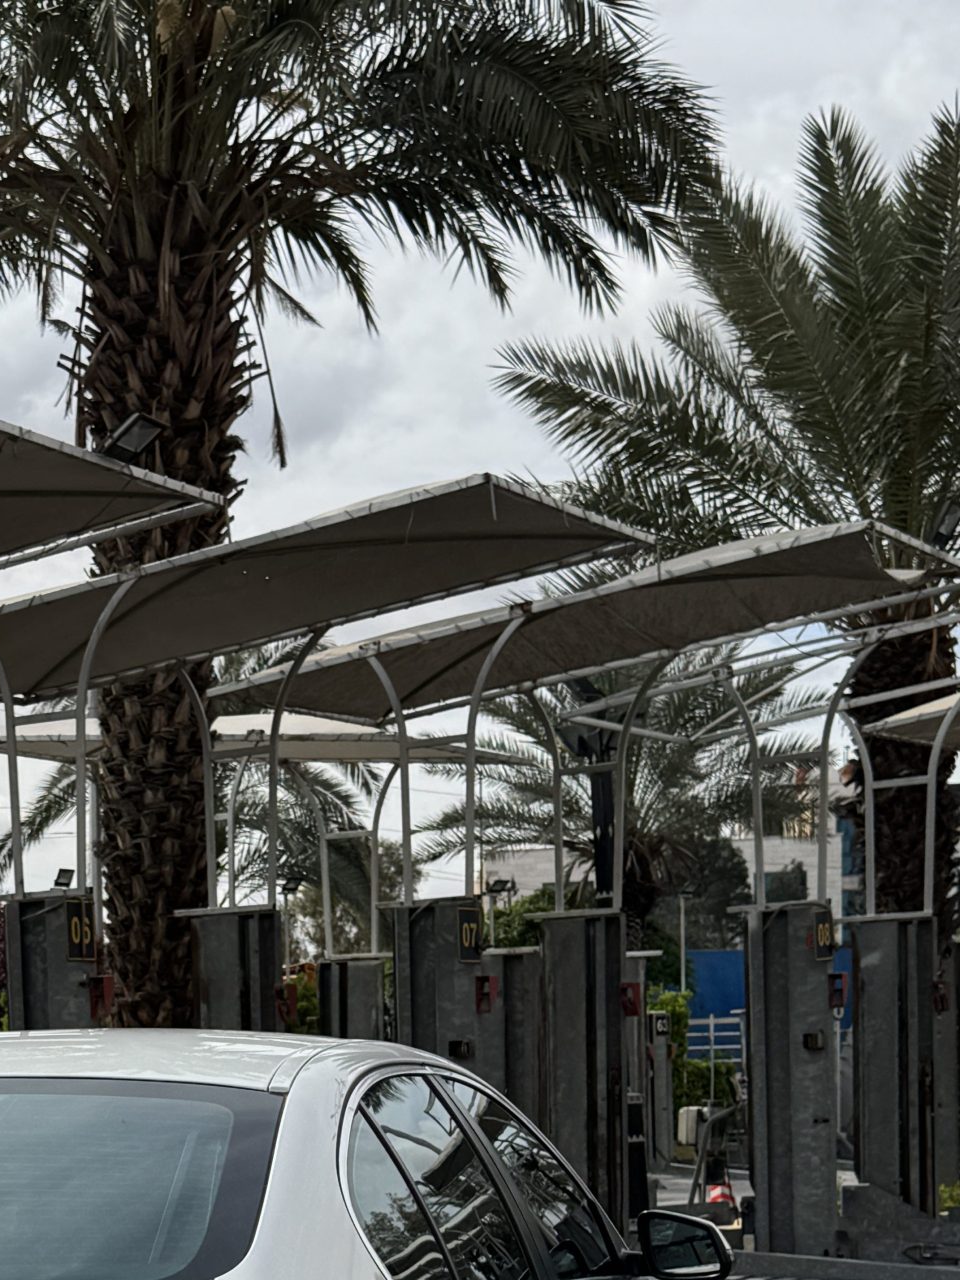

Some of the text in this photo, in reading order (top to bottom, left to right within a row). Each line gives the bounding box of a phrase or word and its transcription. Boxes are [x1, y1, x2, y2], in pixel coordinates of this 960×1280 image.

[71, 915, 91, 944] 06
[462, 923, 477, 947] 07
[818, 923, 831, 946] 08
